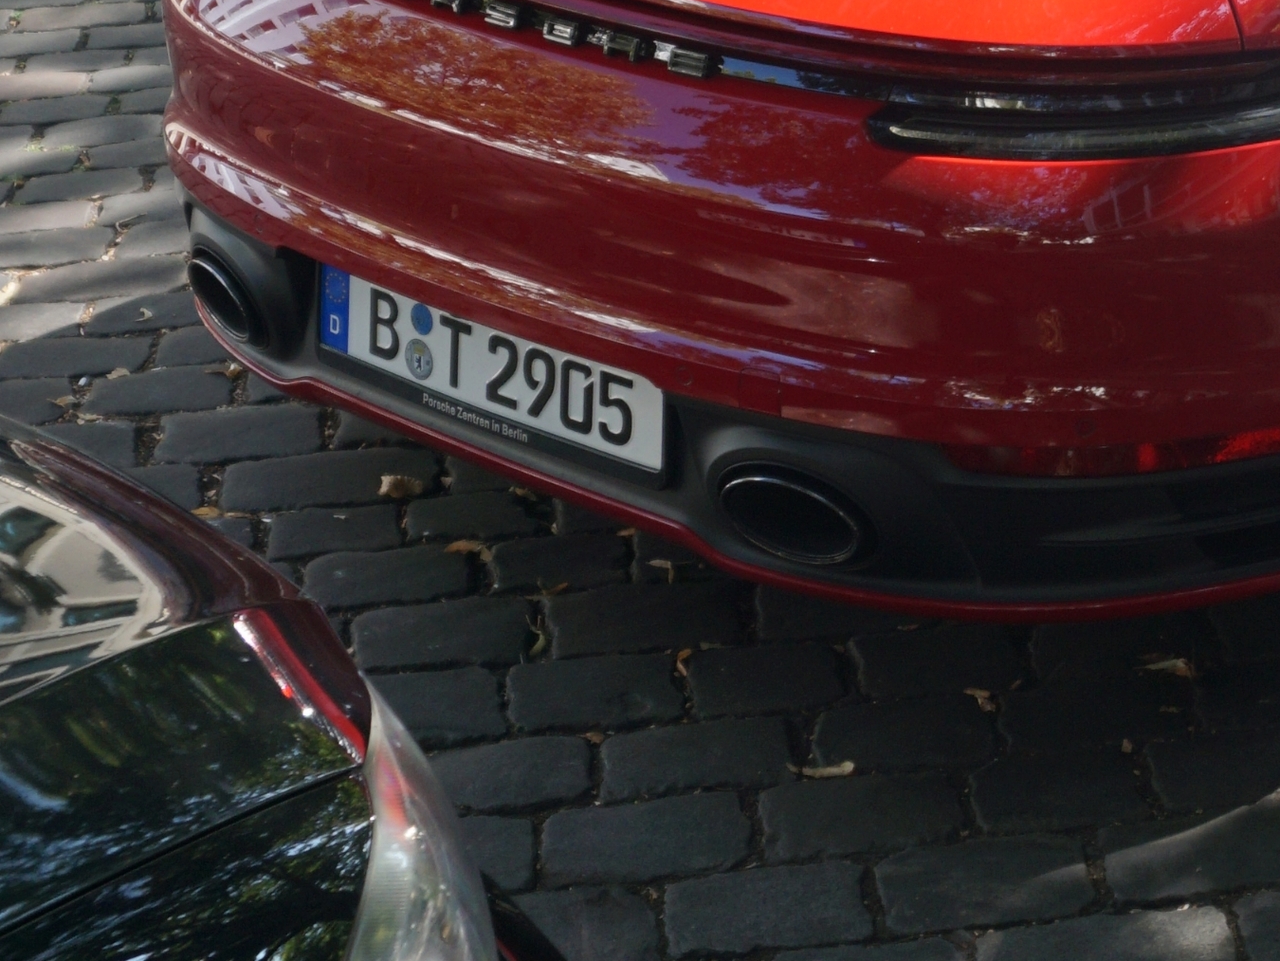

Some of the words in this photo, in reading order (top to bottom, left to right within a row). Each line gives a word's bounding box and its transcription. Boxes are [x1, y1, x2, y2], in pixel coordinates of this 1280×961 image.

[329, 314, 340, 335] D
[369, 287, 400, 361] B
[439, 314, 472, 389] T
[485, 333, 634, 447] 2905
[422, 392, 456, 417] Porsche
[456, 406, 490, 430] Zentren
[491, 419, 501, 434] in
[501, 423, 529, 443] Berlin
